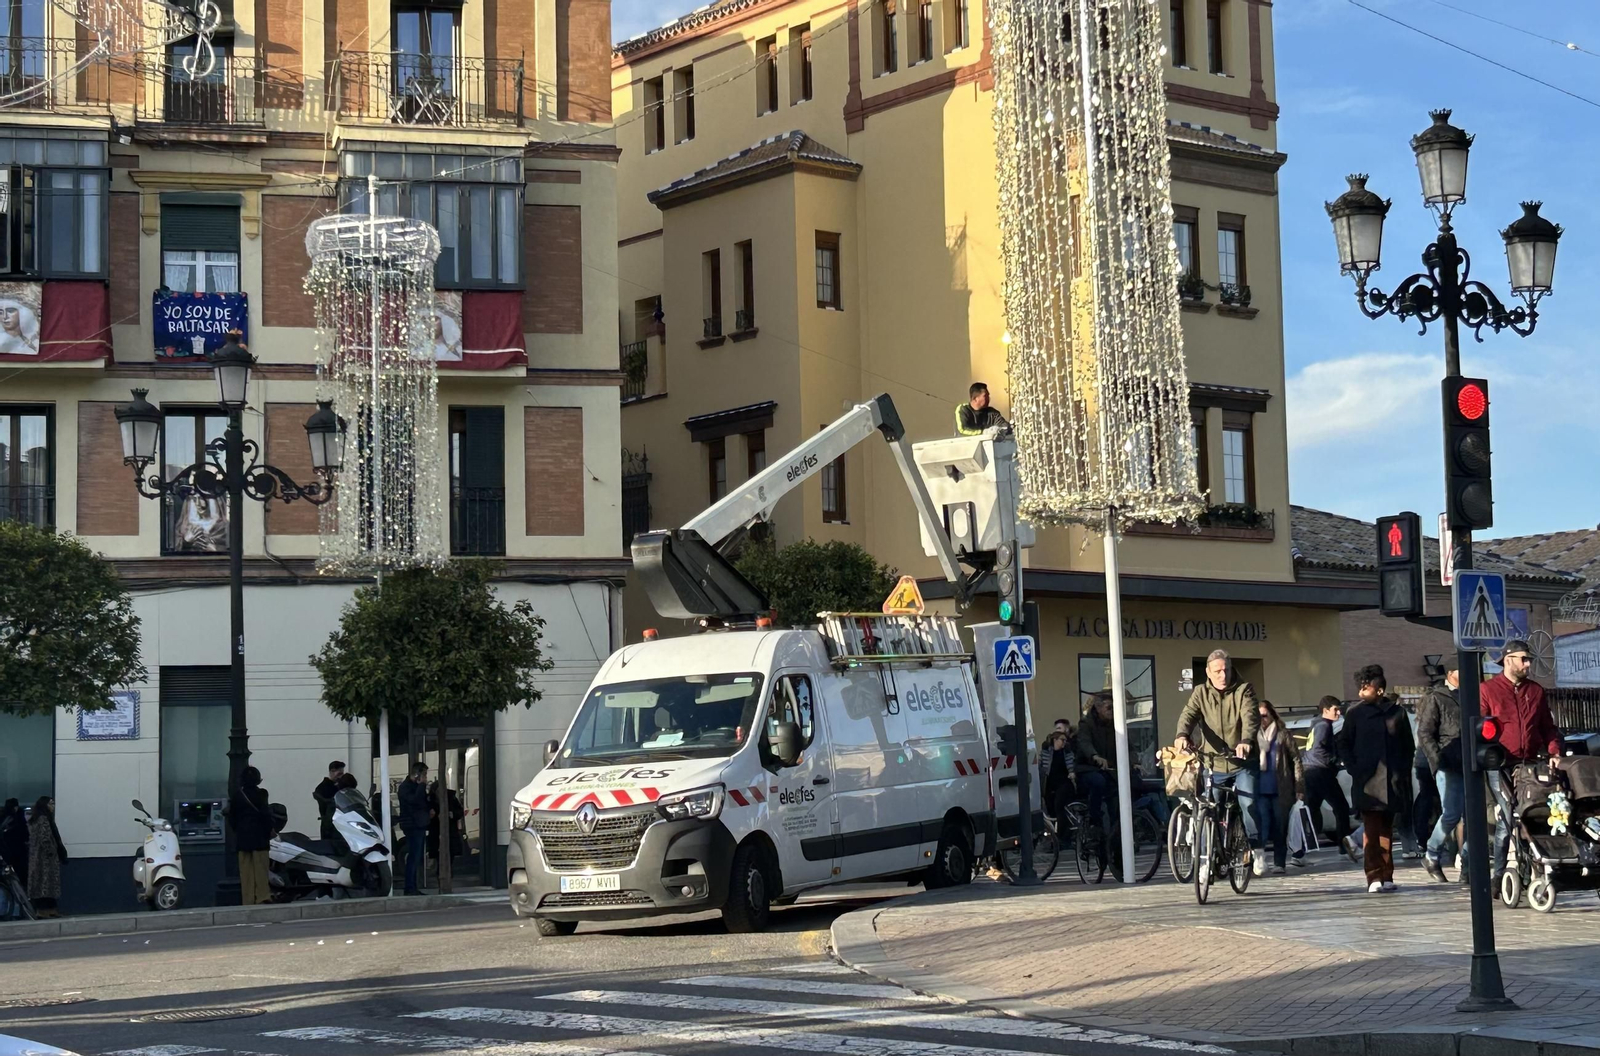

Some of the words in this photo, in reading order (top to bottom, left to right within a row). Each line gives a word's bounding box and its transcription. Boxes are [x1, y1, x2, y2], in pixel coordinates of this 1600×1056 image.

[163, 306, 181, 318] YO
[185, 306, 211, 318] SOY
[215, 307, 231, 320] DE
[168, 320, 231, 333] BALTASAR
[1066, 616, 1092, 637] LA
[1094, 617, 1141, 638] CSA
[1145, 619, 1181, 639] DEL
[569, 878, 591, 889] 8967
